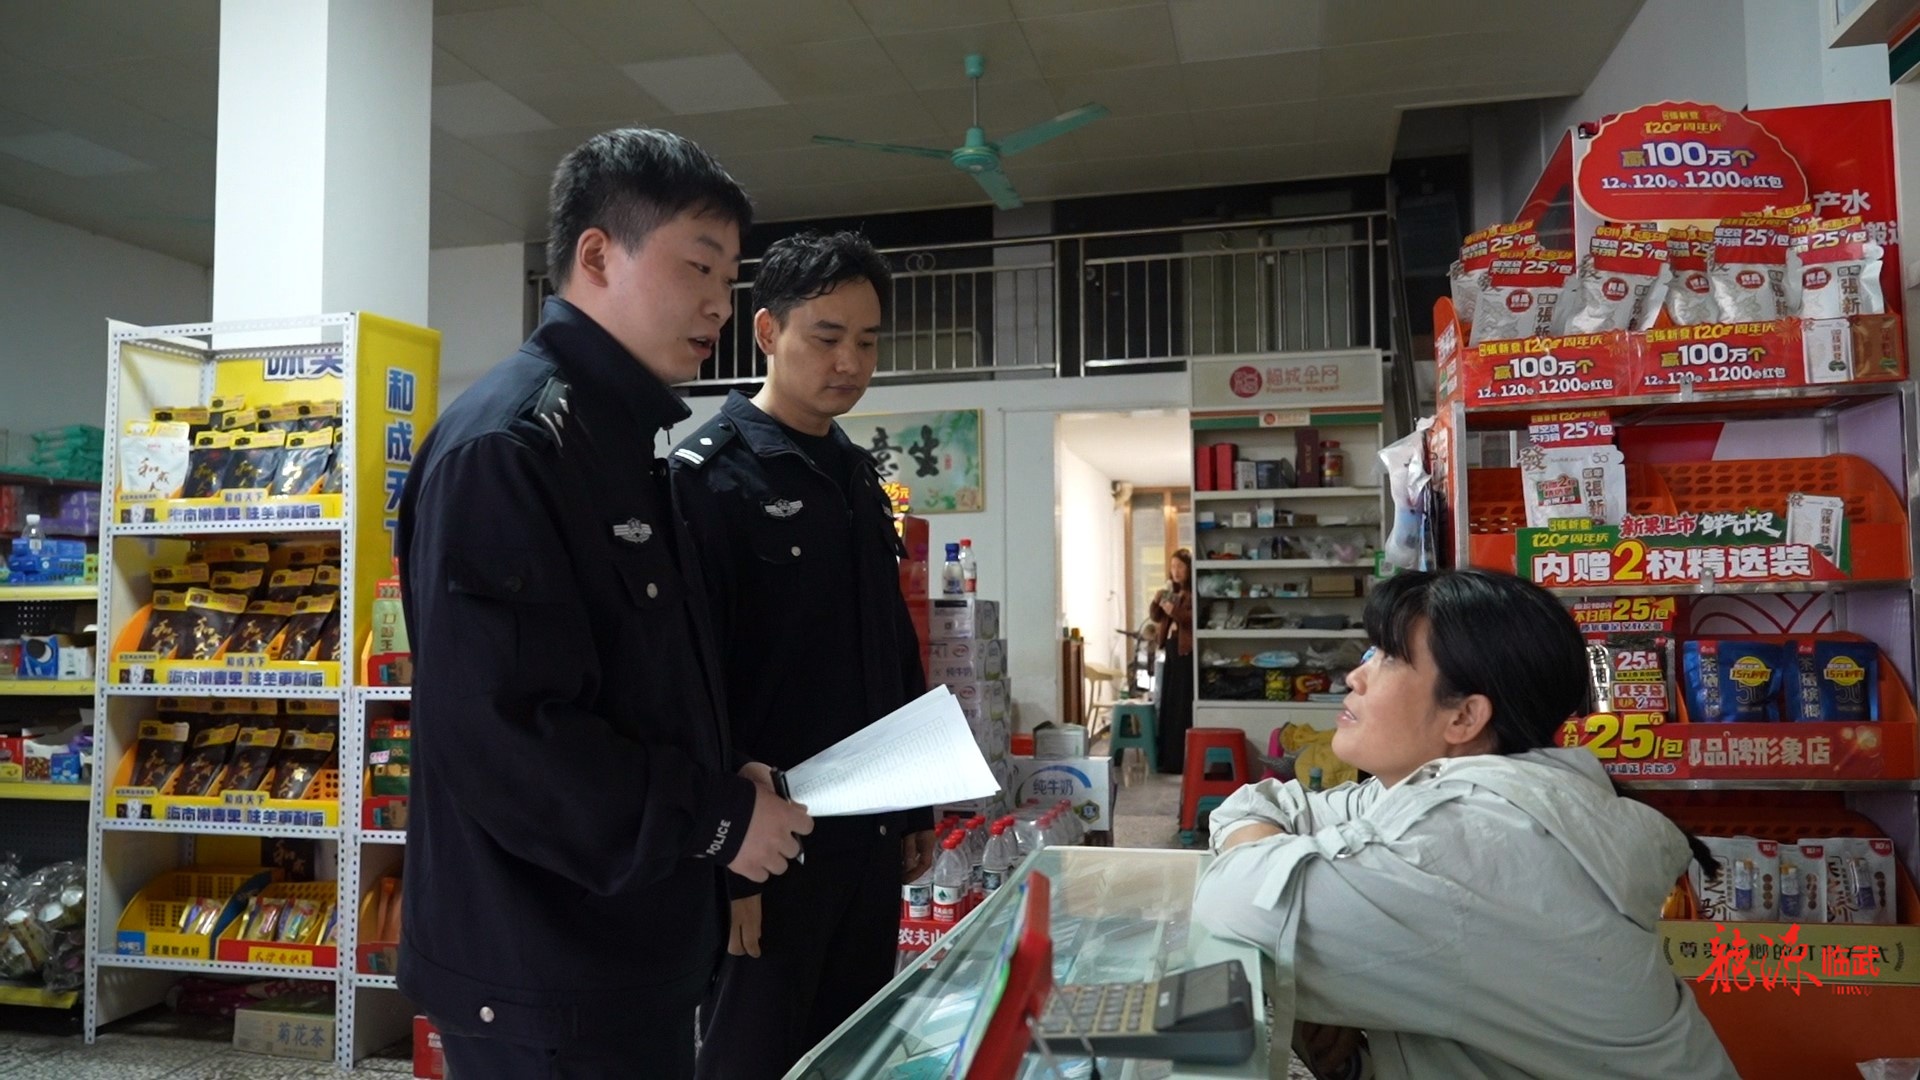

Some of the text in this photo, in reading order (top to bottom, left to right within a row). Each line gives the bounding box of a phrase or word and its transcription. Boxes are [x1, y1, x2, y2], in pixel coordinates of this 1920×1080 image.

[1621, 142, 1755, 167] 赢100万个
[1813, 189, 1871, 215] 产水
[1494, 355, 1594, 380] 赢100万个
[1661, 342, 1766, 368] 赢100万个
[1620, 512, 1698, 538] 新果上市
[1033, 779, 1074, 796] 纯牛奶
[706, 819, 731, 855] POLICE
[277, 1021, 325, 1048] 菊花茶
